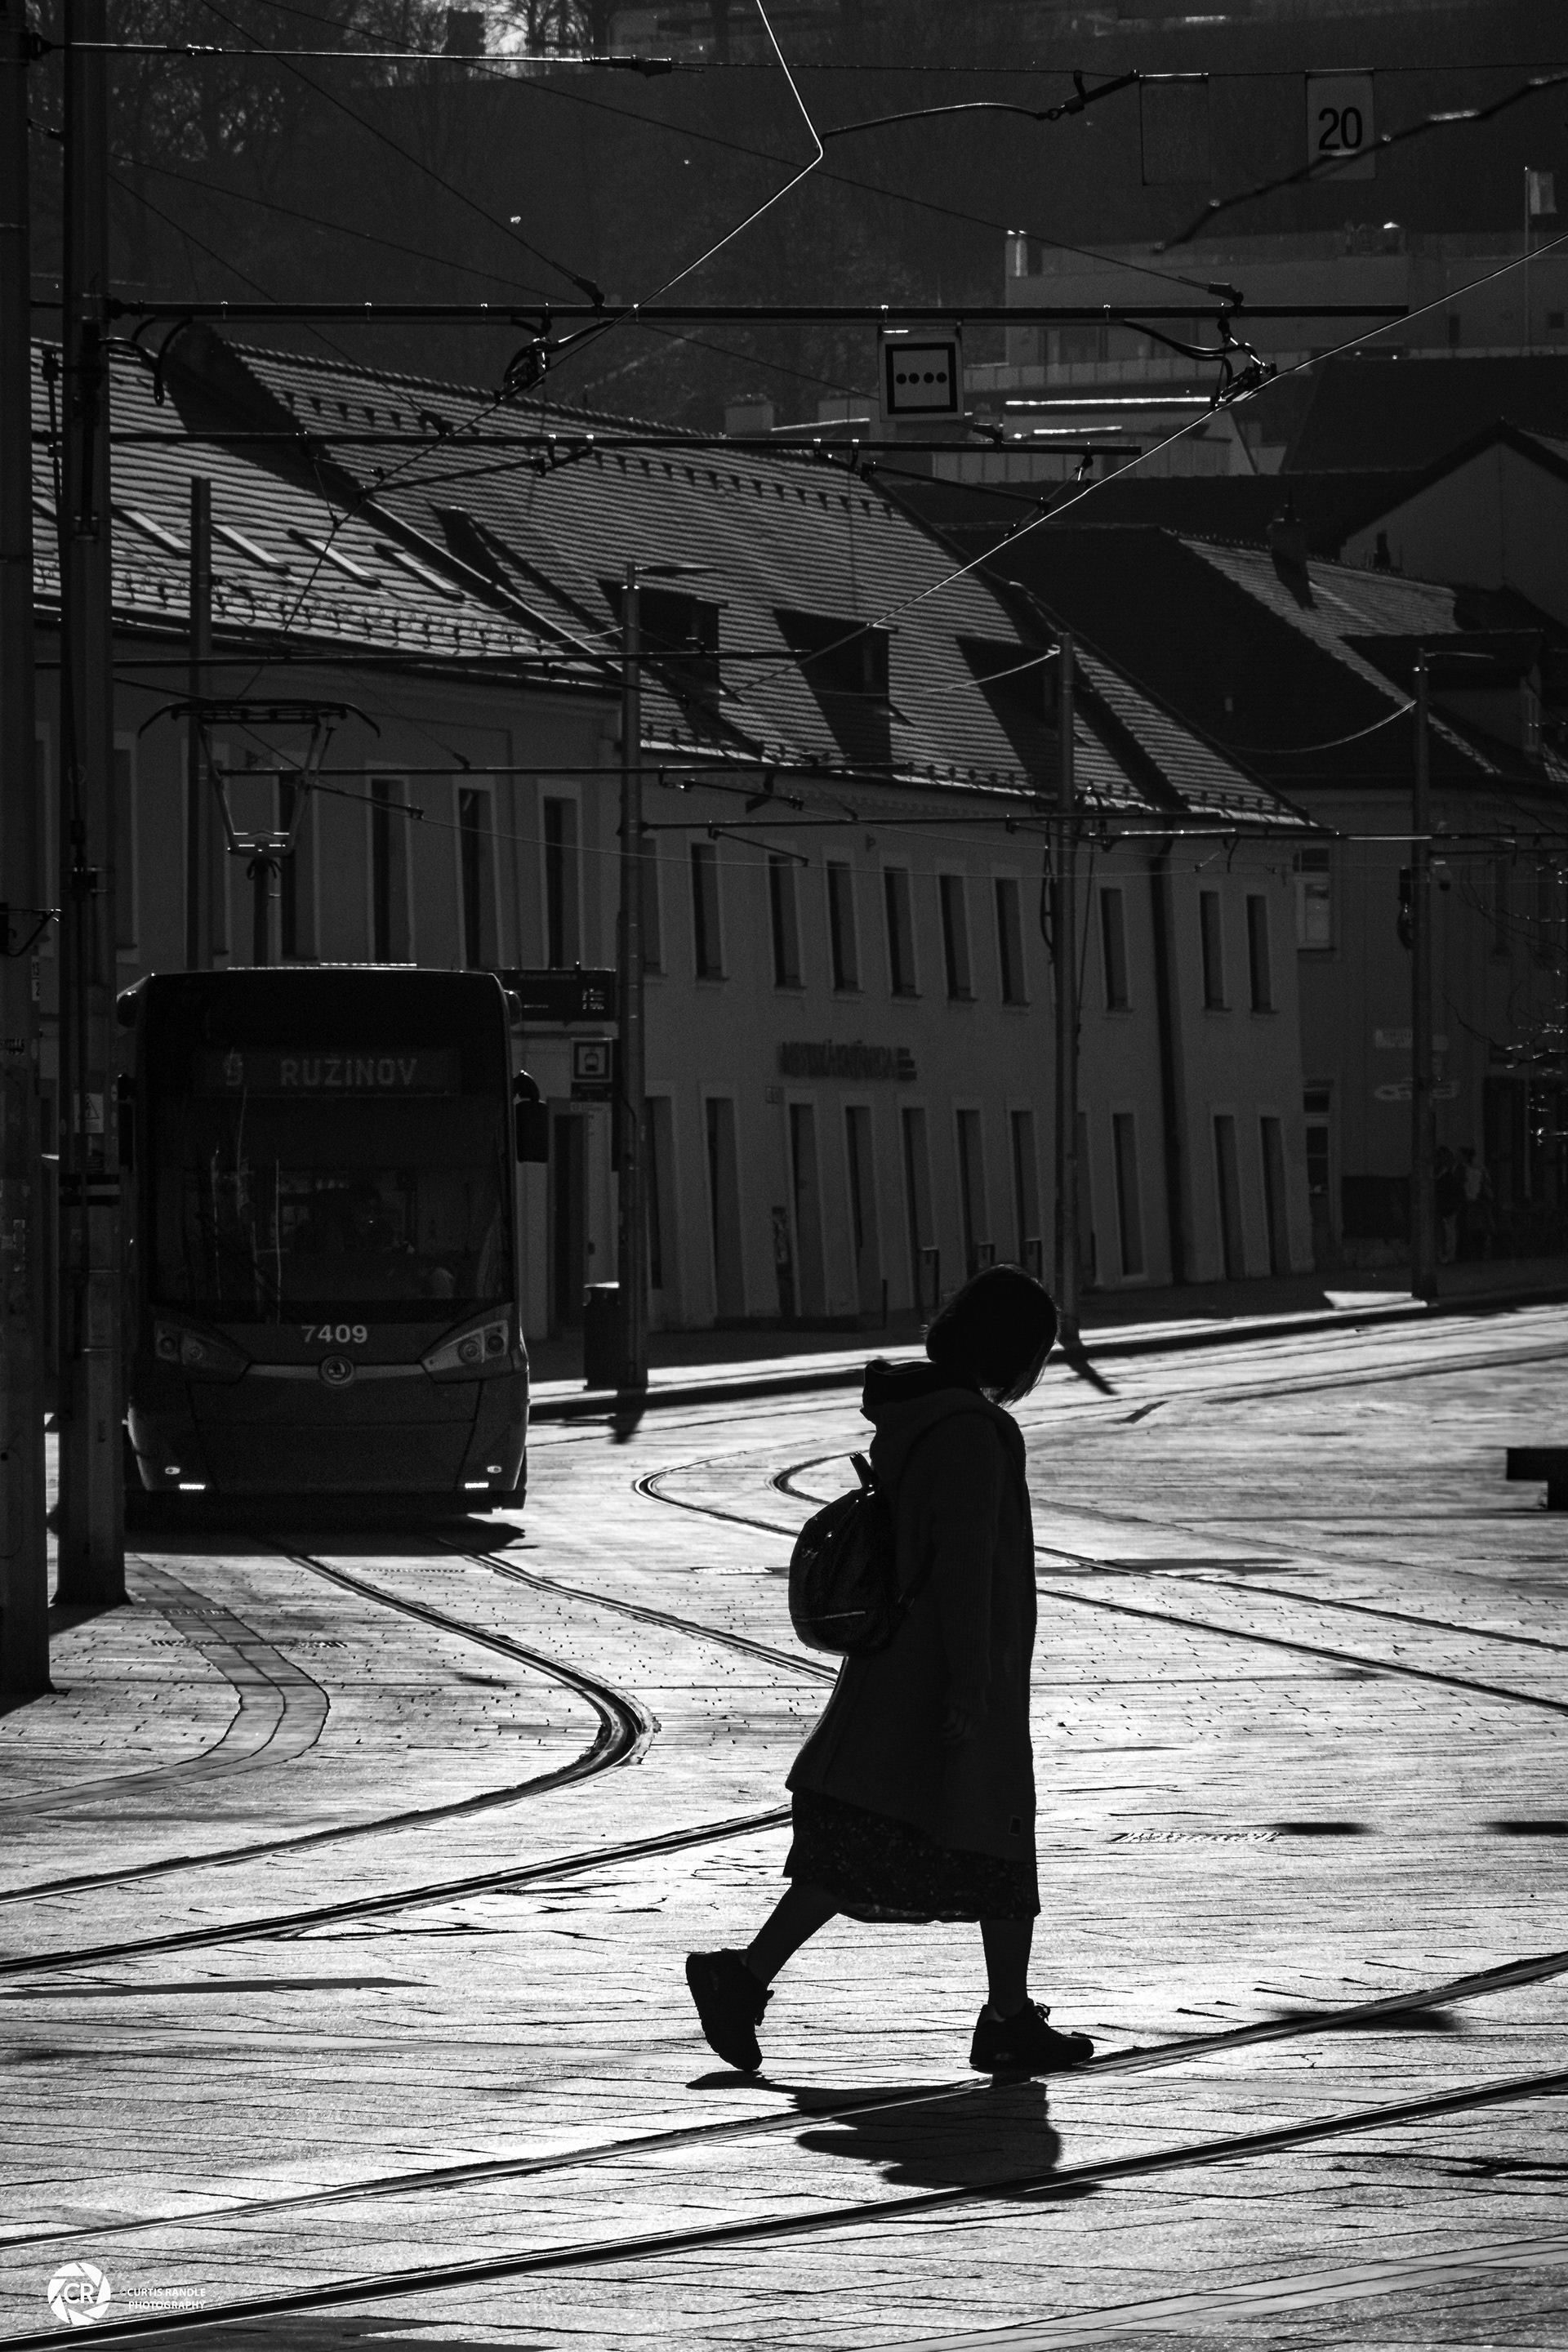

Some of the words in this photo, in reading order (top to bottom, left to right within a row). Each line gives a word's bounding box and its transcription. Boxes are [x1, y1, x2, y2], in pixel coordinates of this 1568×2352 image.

[1318, 106, 1363, 150] 20
[280, 1053, 418, 1087] RUŽINOV
[301, 1324, 368, 1343] 7409
